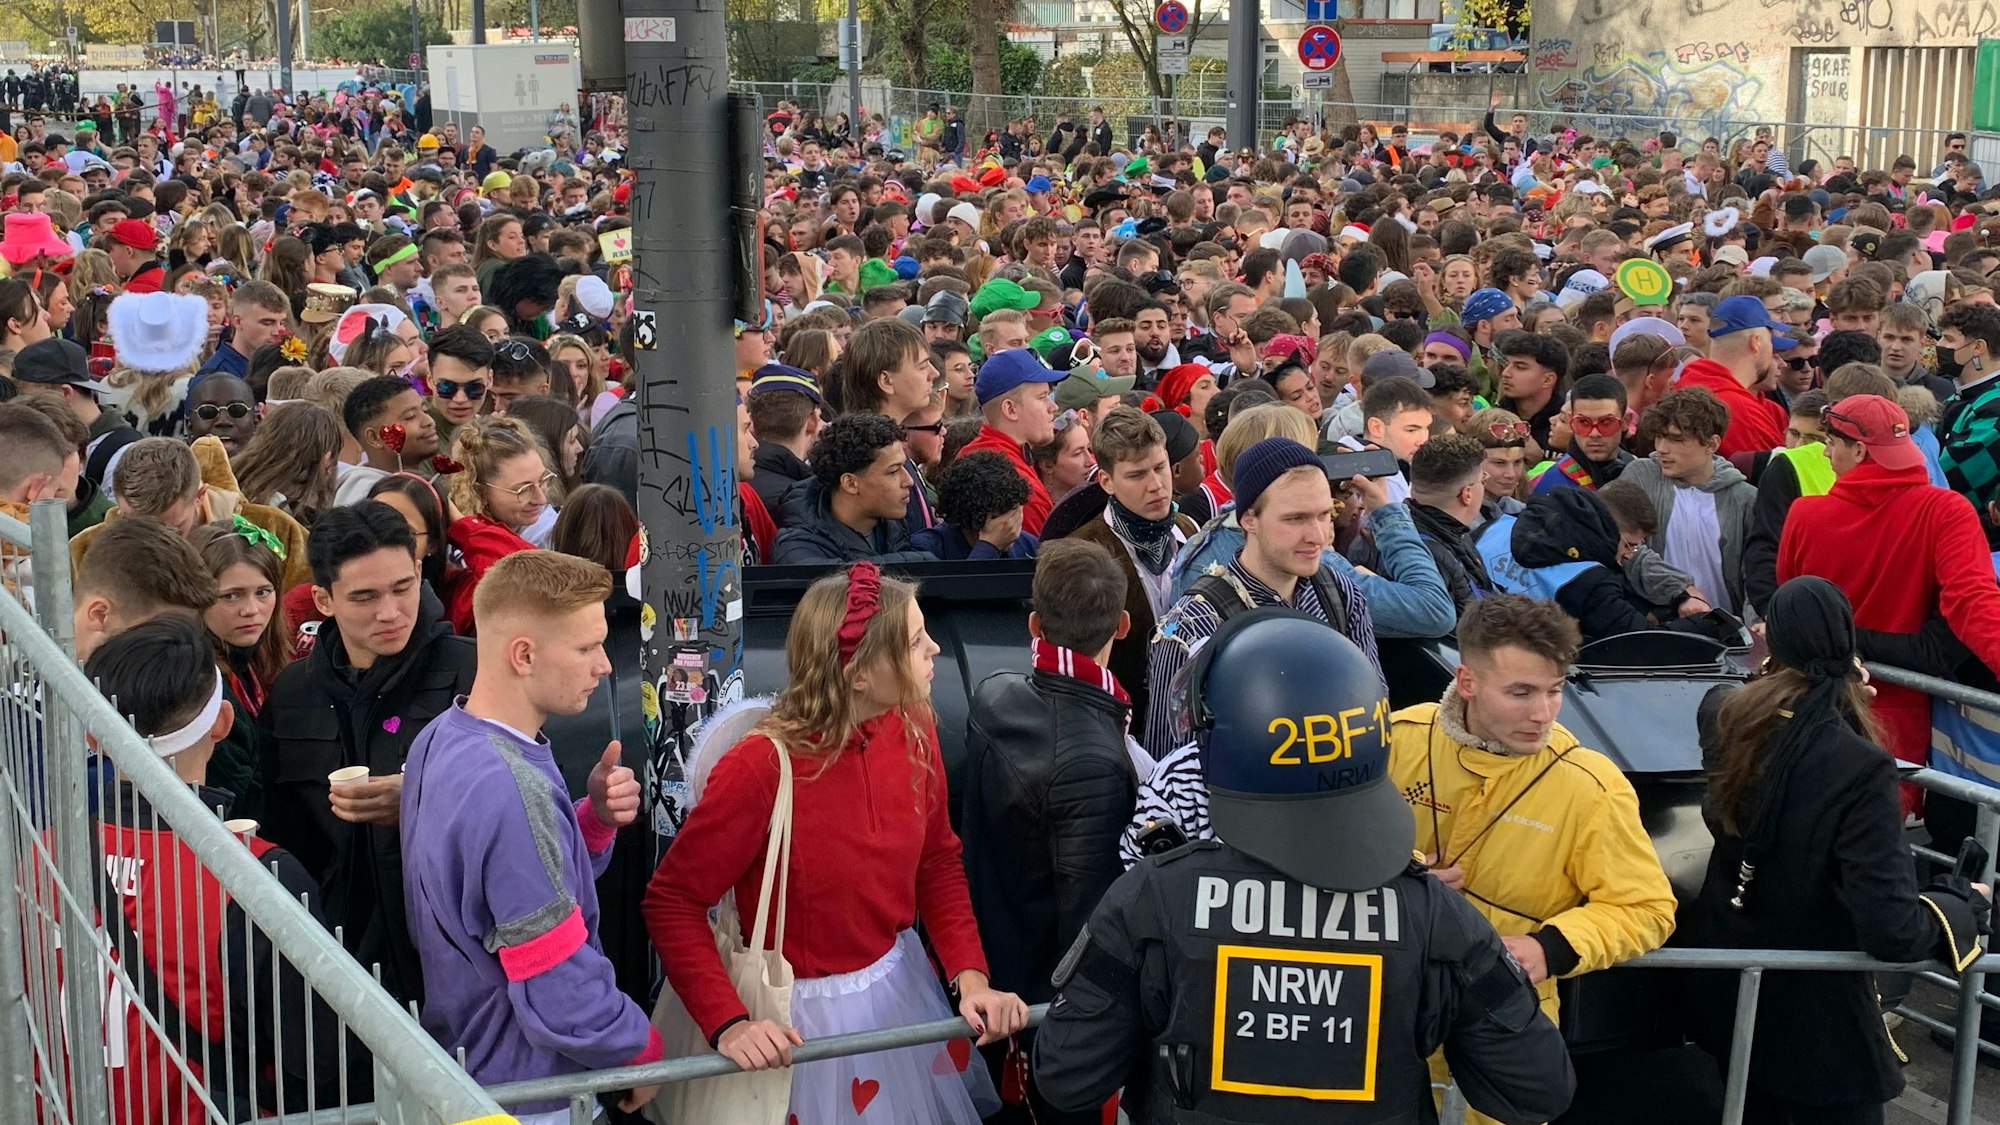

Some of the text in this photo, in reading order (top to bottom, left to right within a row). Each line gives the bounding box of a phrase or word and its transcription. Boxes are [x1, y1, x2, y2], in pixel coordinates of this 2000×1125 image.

[1635, 271, 1656, 290] H
[1194, 876, 1400, 942] POLIZEI
[1252, 965, 1344, 1006] NRW
[1236, 1010, 1353, 1044] 2 BF 11
